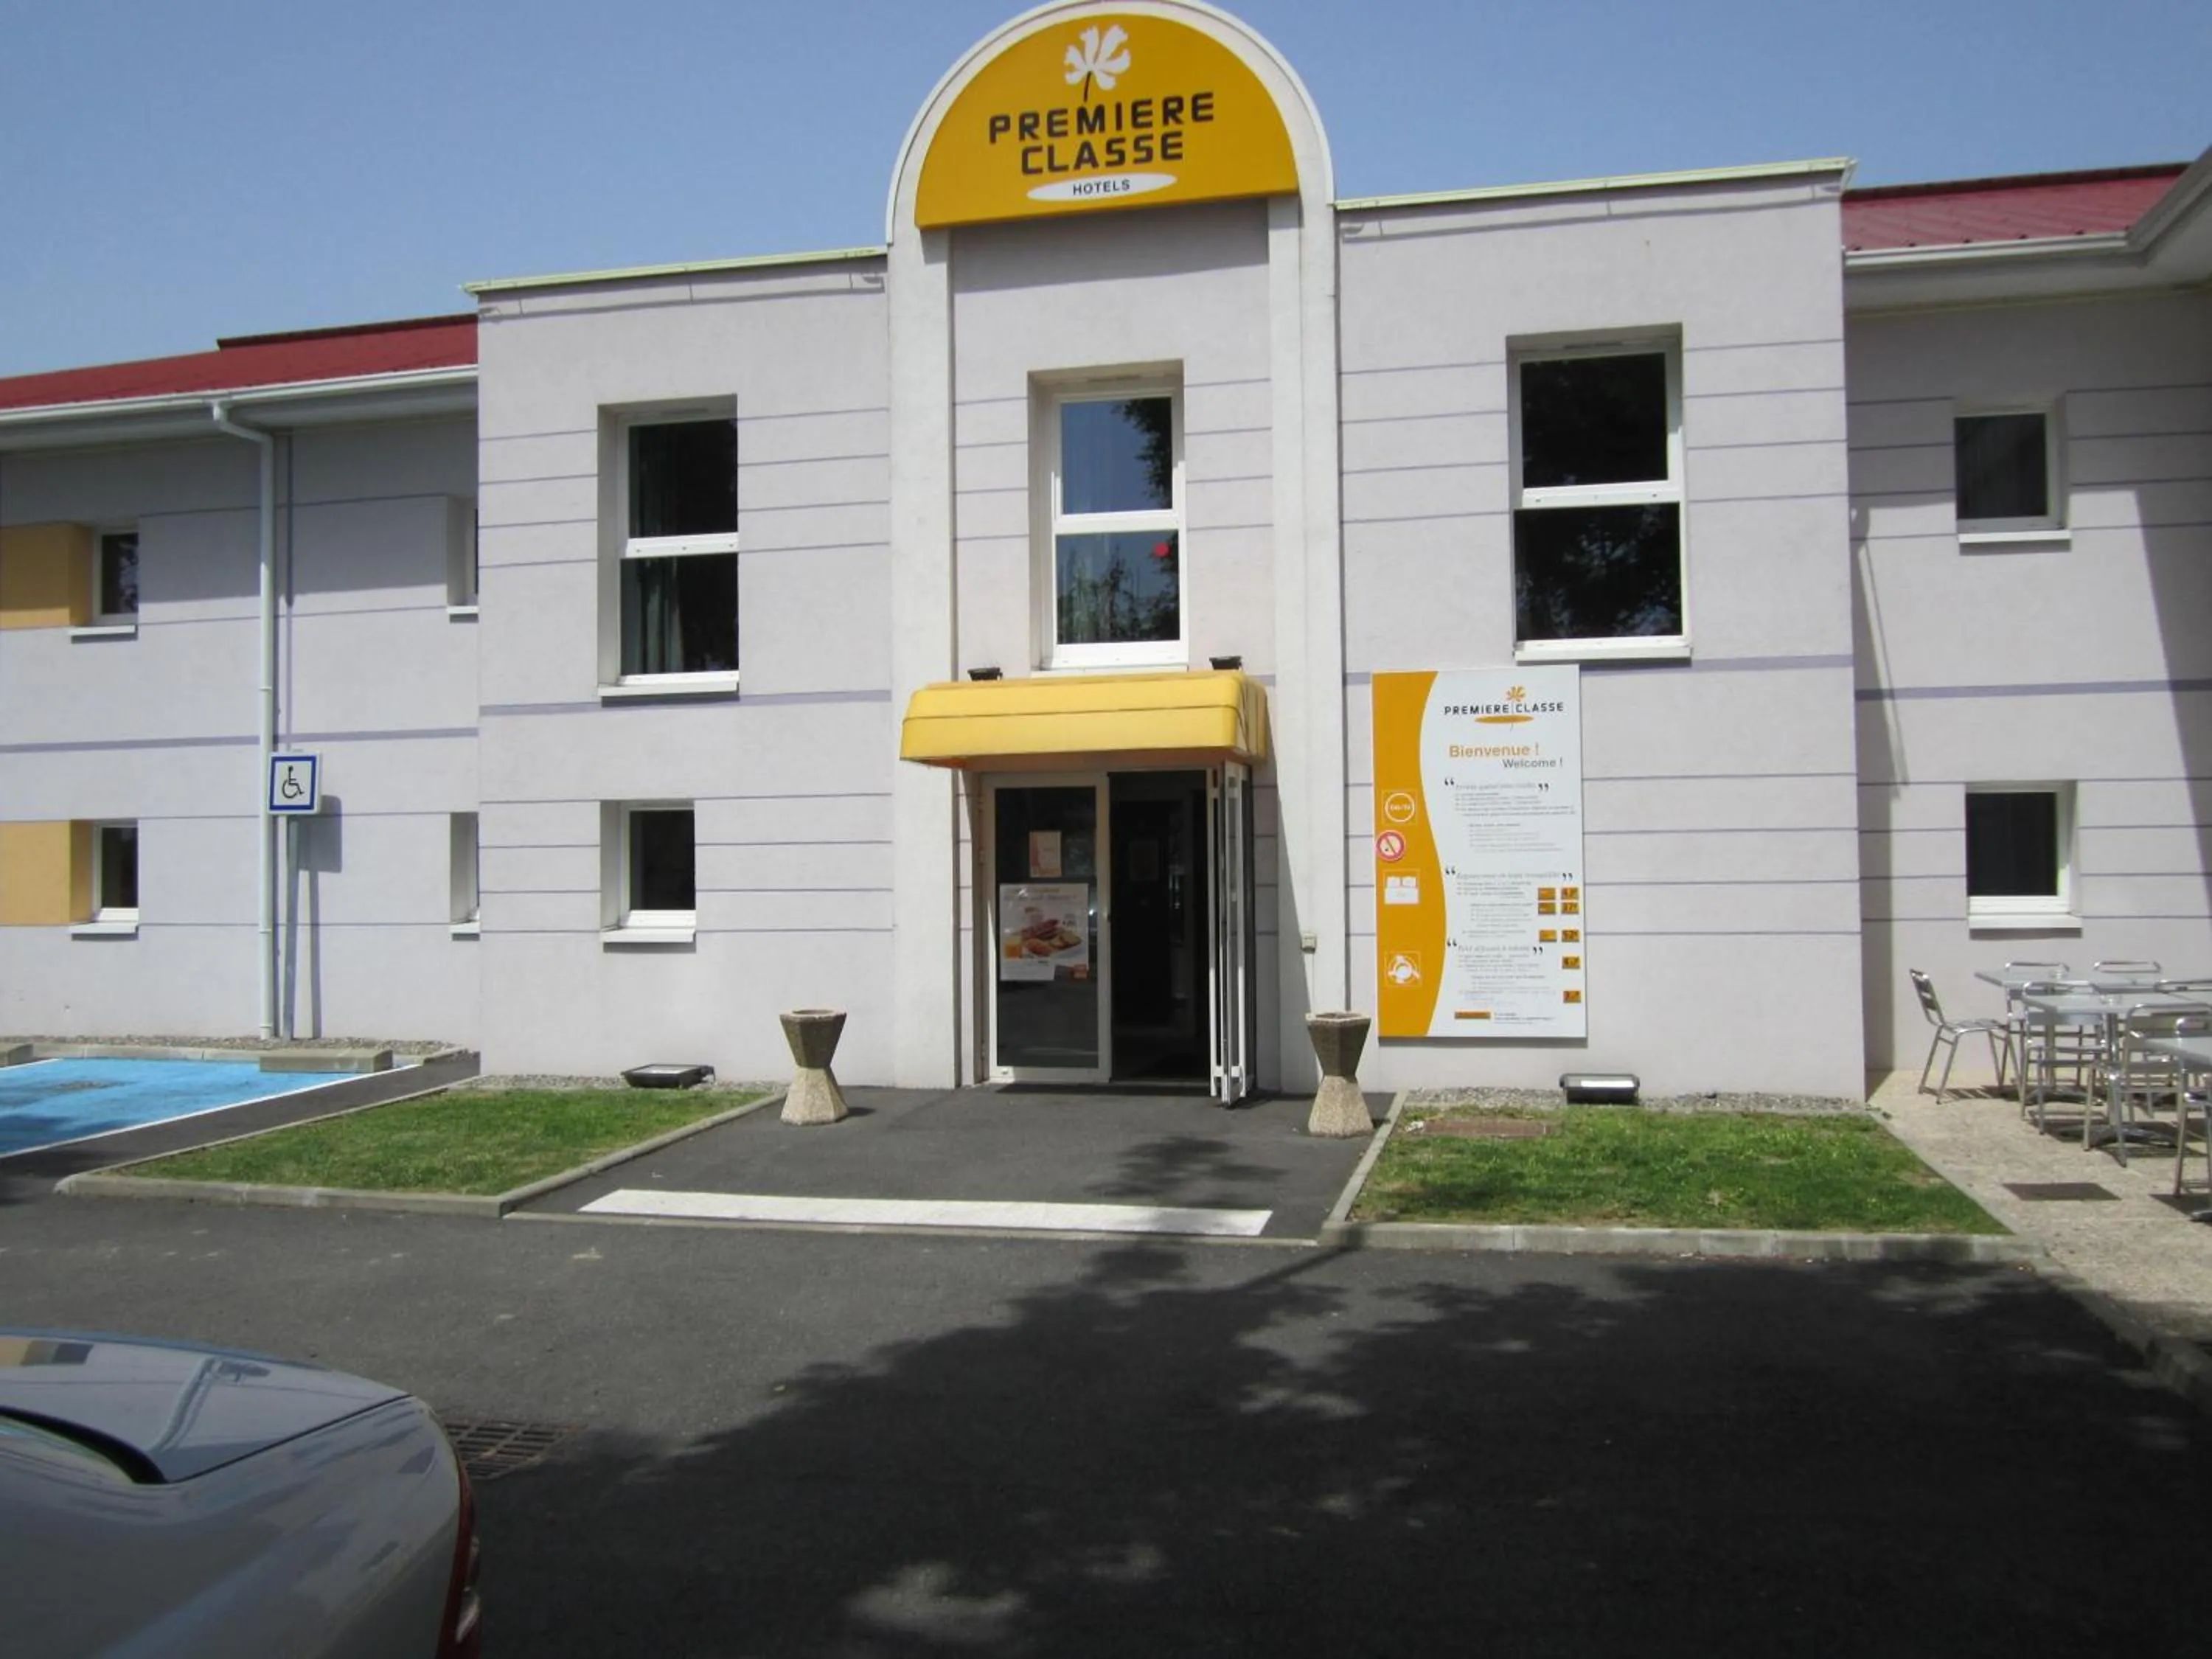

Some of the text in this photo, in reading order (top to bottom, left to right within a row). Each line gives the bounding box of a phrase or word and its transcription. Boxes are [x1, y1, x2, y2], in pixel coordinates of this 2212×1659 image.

[989, 91, 1214, 145] PREMIERE
[1021, 131, 1183, 175] CLASSE
[1073, 179, 1131, 196] HOTELS
[1444, 702, 1564, 714] PREMIERE CLASSE
[1450, 745, 1530, 758] Bienvenue
[1502, 758, 1557, 768] Welcome
